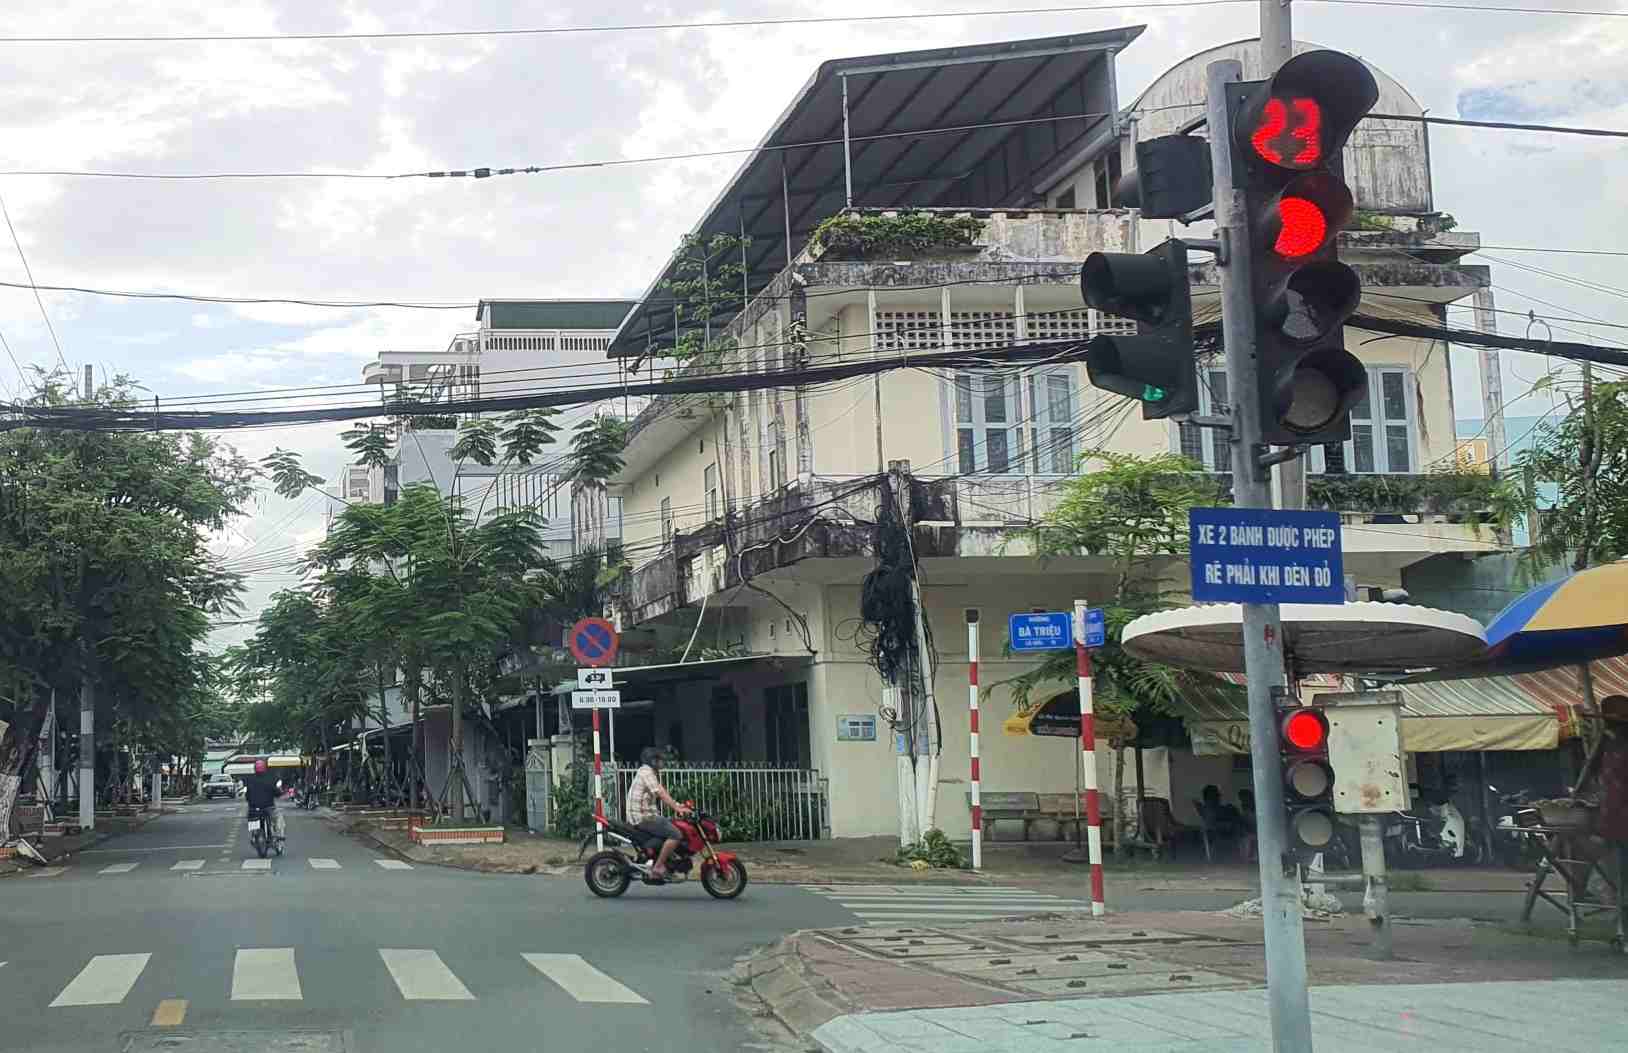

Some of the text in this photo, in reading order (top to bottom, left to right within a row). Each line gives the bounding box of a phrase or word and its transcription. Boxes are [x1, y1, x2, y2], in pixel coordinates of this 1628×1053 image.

[1252, 97, 1321, 164] 23
[1198, 521, 1335, 551] XE 2 BÁNH ĐƯỢC PHÉP
[1226, 558, 1255, 585] PHẢI
[1259, 565, 1280, 586] KHI
[1284, 562, 1310, 587] ĐÈN
[1314, 560, 1332, 587] ĐỎ
